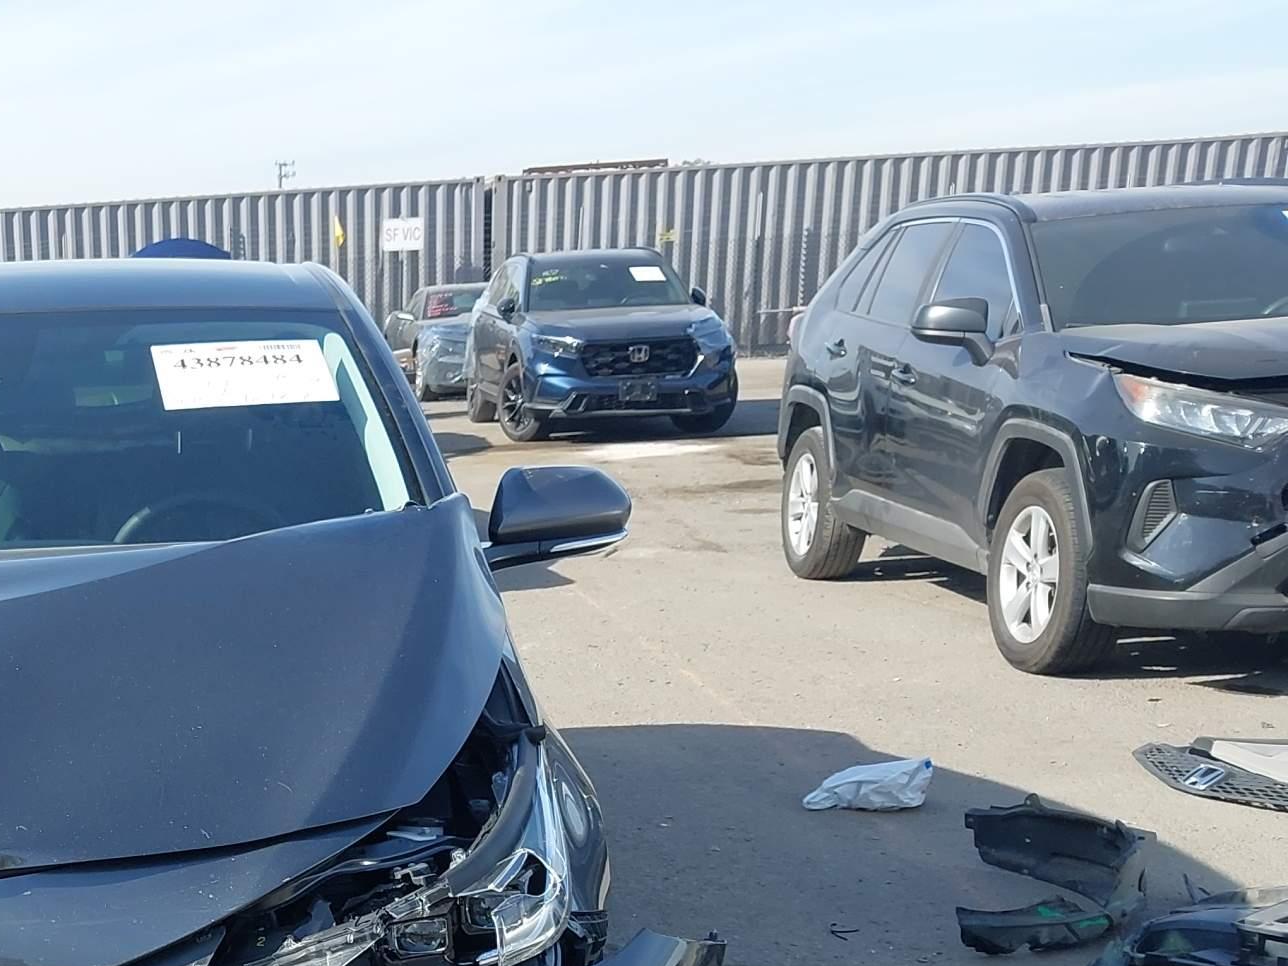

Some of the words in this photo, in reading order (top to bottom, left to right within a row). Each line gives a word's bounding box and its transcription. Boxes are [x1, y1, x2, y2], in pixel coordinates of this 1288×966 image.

[385, 227, 400, 242] SF
[402, 226, 422, 241] VIC
[173, 353, 304, 370] 43878484
[255, 936, 266, 947] 2
